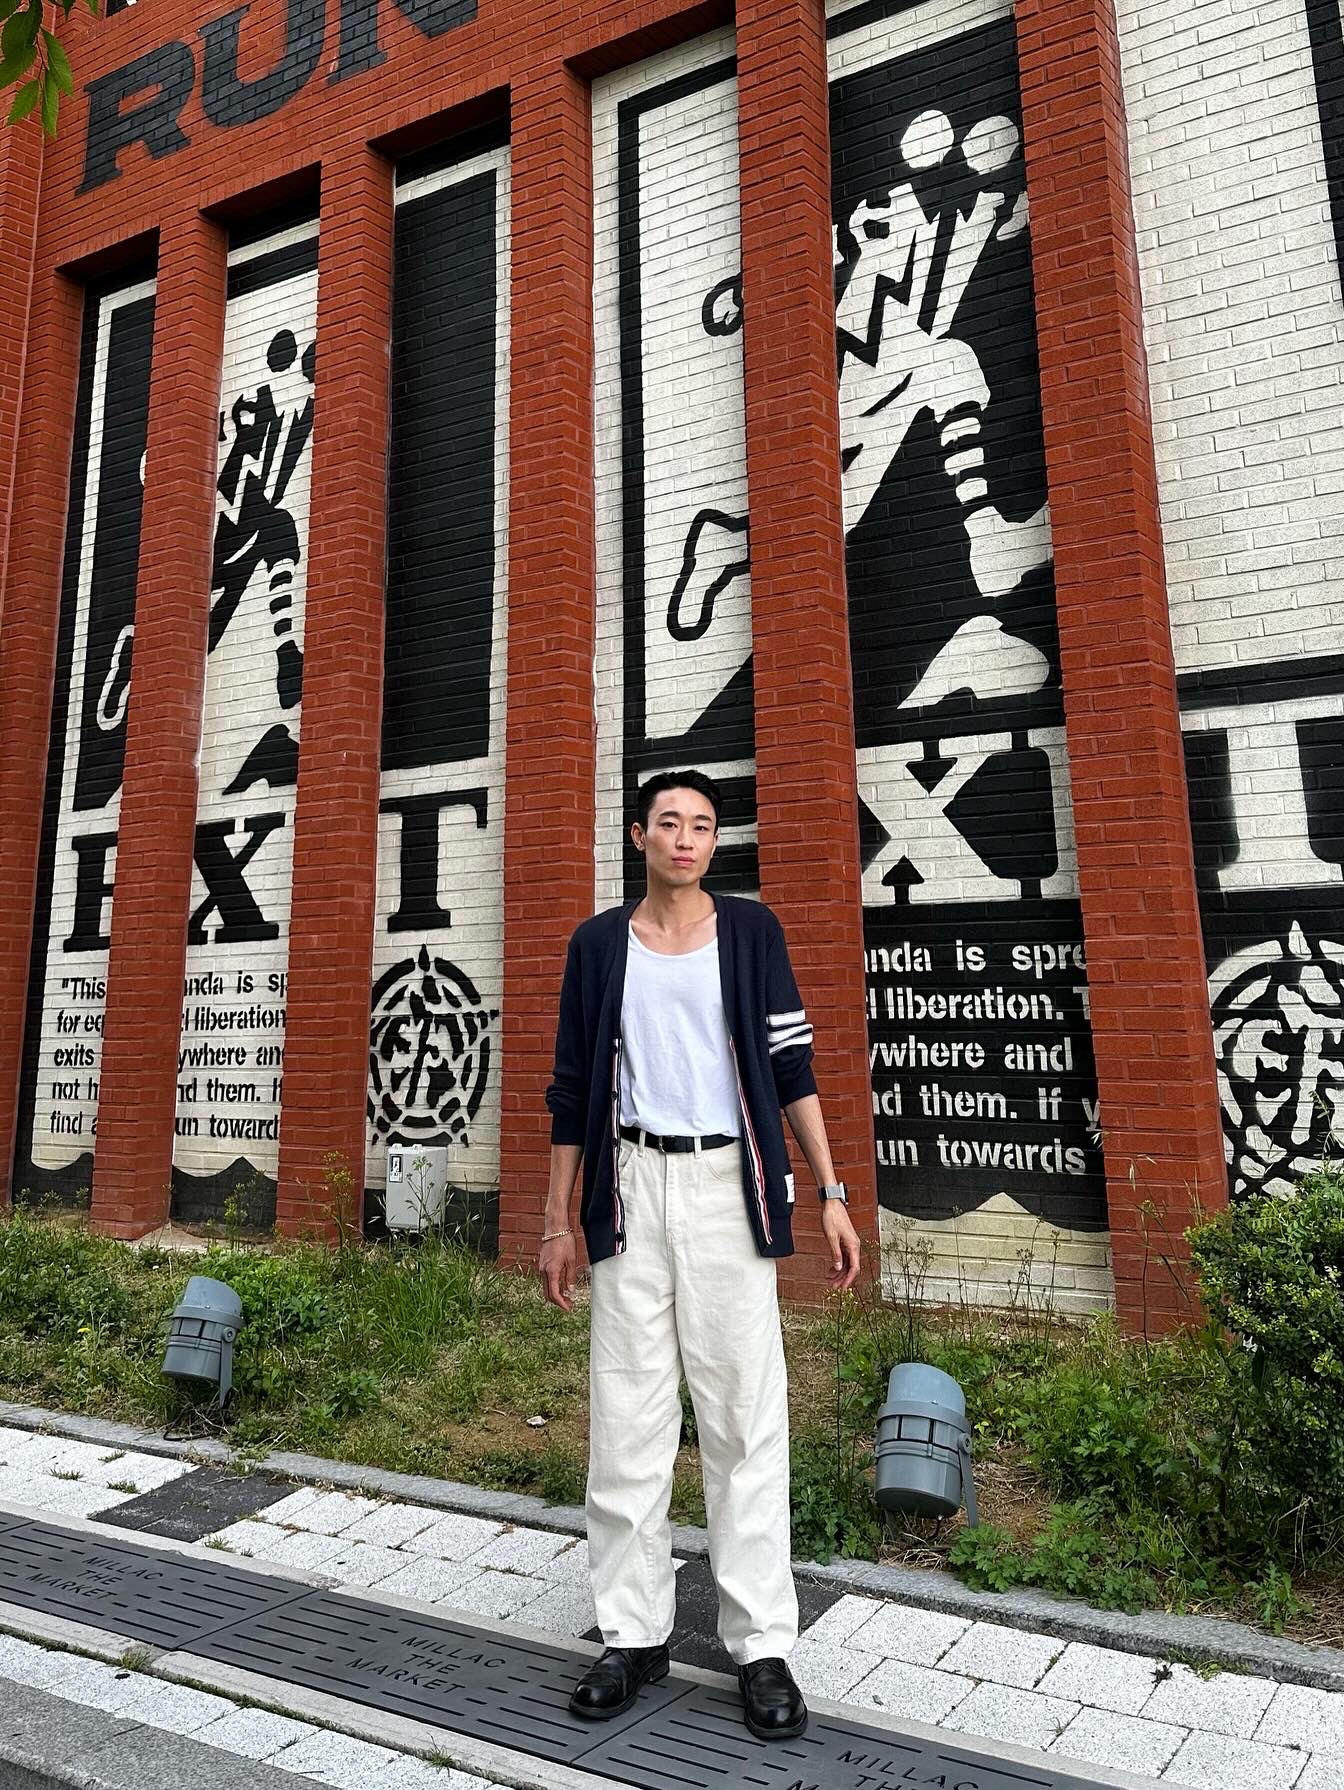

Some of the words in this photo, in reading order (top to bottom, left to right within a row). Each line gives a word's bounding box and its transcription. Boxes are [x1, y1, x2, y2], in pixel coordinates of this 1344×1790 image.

[955, 939, 986, 971] is
[1012, 943, 1088, 979] spre
[237, 970, 254, 994] is
[886, 986, 1064, 1020] liberation.
[57, 1009, 81, 1034] for
[53, 1042, 95, 1067] exits
[178, 1042, 247, 1074] ywhere
[256, 1045, 285, 1067] an
[869, 1034, 985, 1072] ywhere
[1004, 1036, 1073, 1072] and
[52, 1078, 81, 1100] not
[207, 1077, 261, 1102] them.
[919, 1082, 1018, 1119] them.
[50, 1111, 83, 1135] find
[209, 1114, 279, 1141] toward
[937, 1134, 1087, 1176] towards
[77, 1569, 123, 1586] THE
[82, 1556, 164, 1581] MILLAC
[26, 1573, 118, 1600] MARKET
[401, 1636, 506, 1668] MILLAC
[403, 1653, 461, 1675] THE
[346, 1657, 466, 1694] MARKET
[836, 1750, 979, 1790] MILLAC
[854, 1774, 920, 1790] TH
